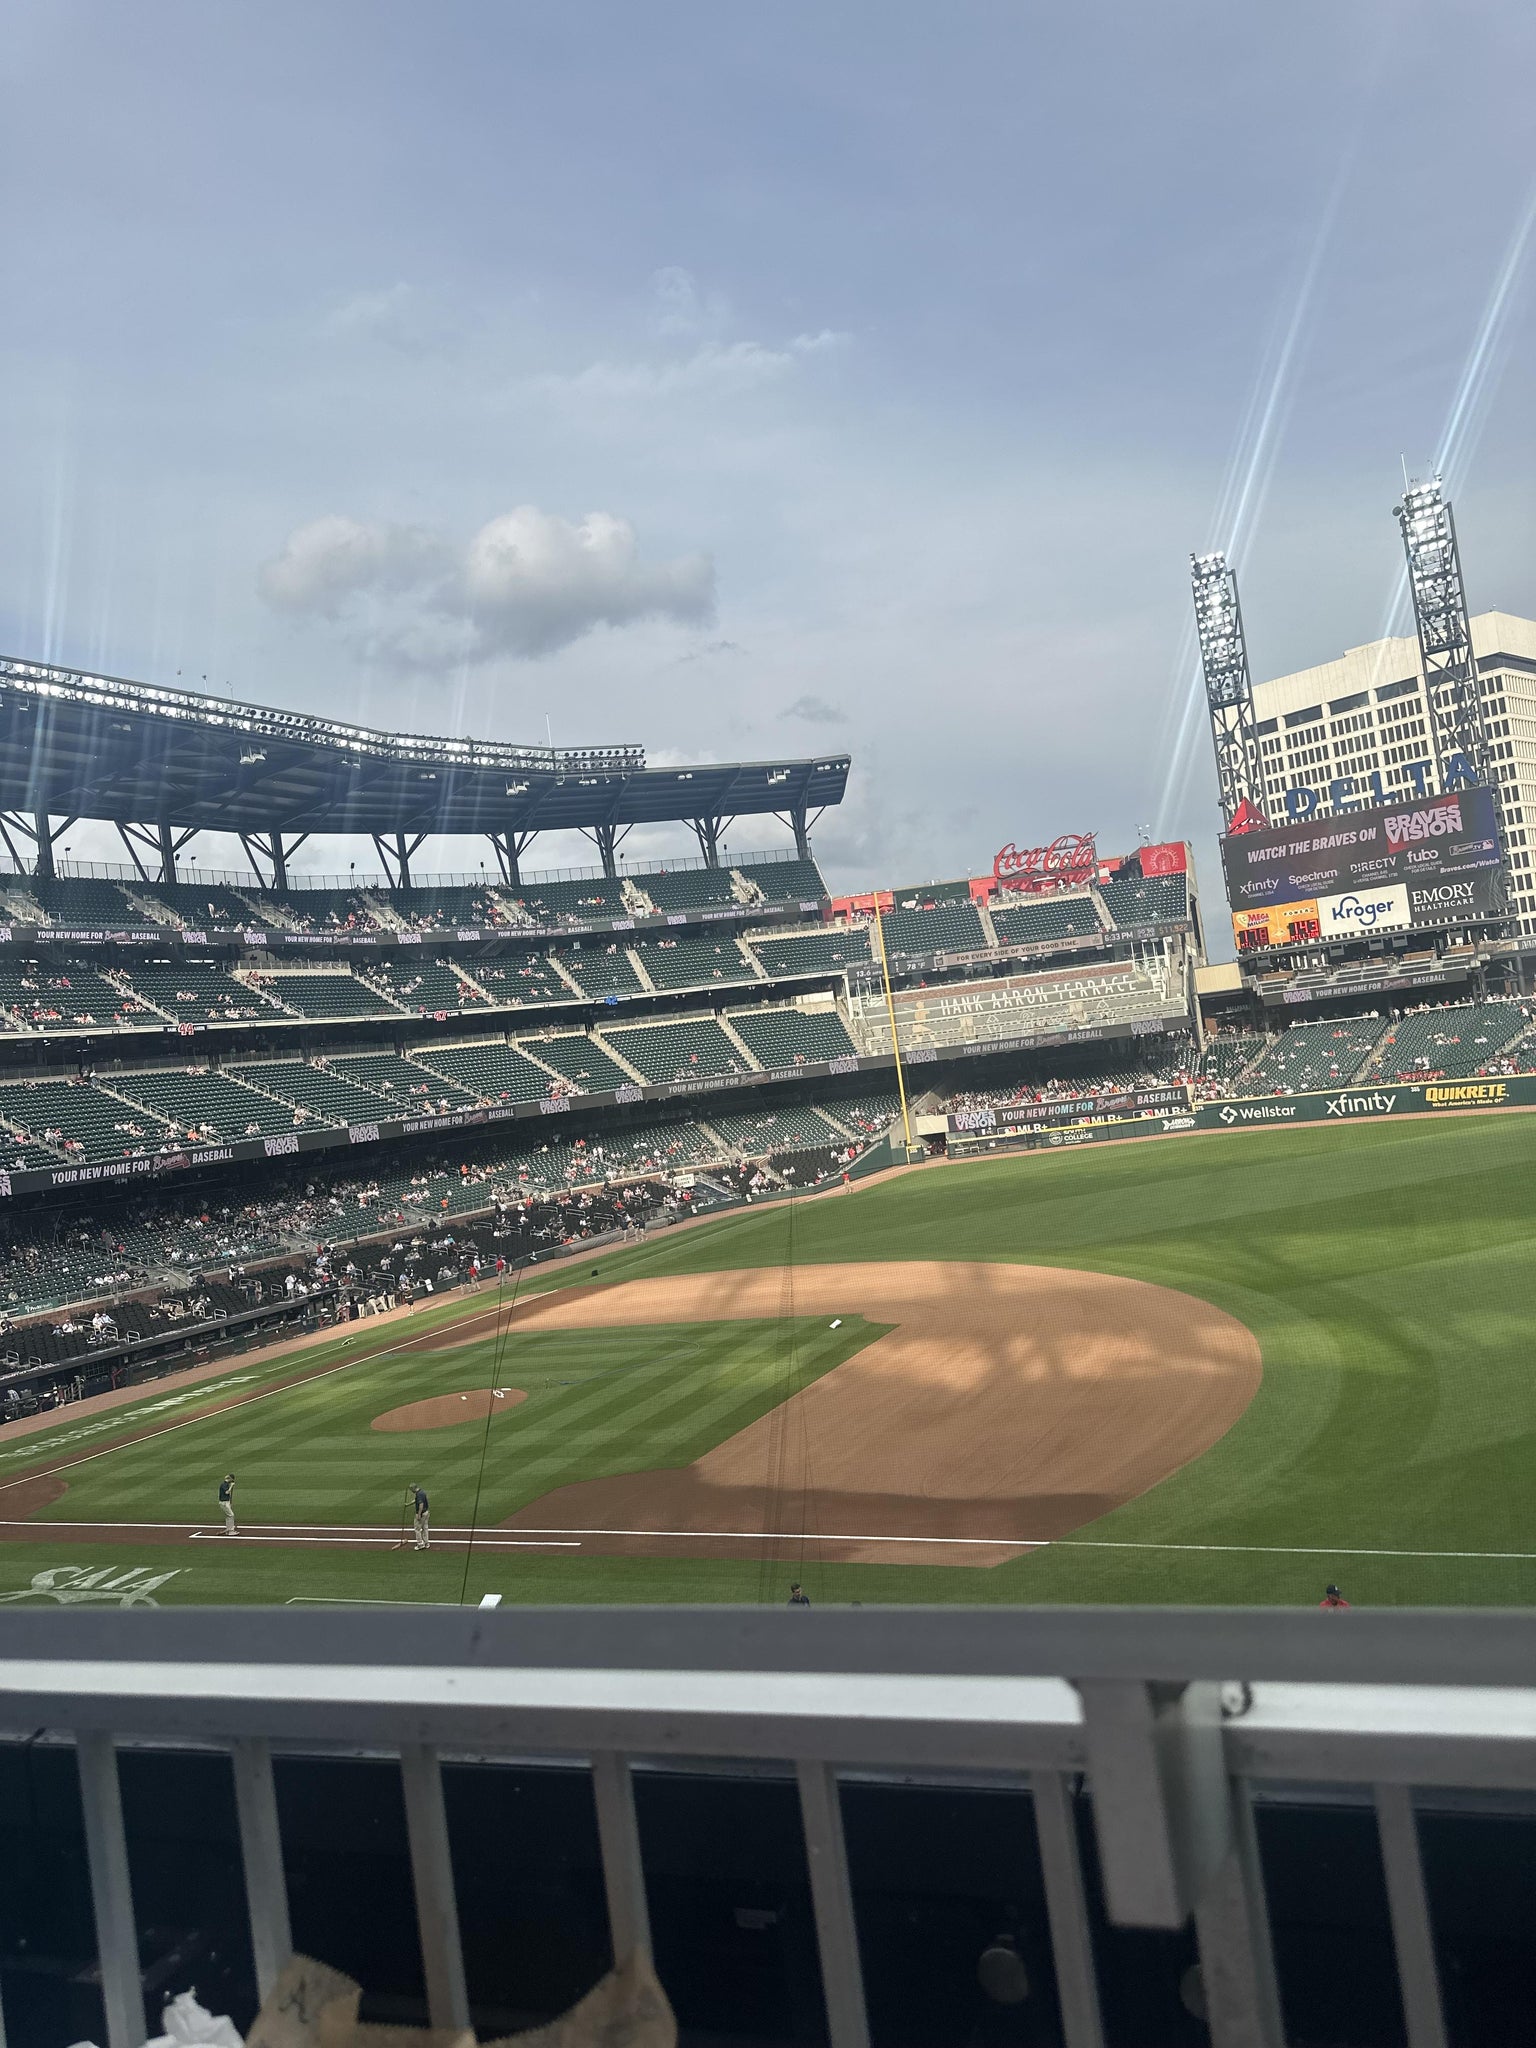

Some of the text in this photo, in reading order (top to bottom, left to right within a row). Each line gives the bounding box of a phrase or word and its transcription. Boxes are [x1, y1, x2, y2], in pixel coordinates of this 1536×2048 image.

[1285, 753, 1479, 820] DELTA
[1384, 805, 1461, 831] BRAVES
[1386, 817, 1463, 844] VISION
[1247, 827, 1377, 864] WATCH THE BRAVES ON
[993, 831, 1098, 879] Coca-Cola
[1407, 849, 1439, 863] fubo
[1350, 856, 1397, 874] DIRECTV
[1440, 858, 1500, 874] Braves.com/Watch
[1288, 869, 1338, 885] Spectrum
[1240, 877, 1279, 895] xfinity
[1411, 881, 1475, 905] EMORY
[1332, 896, 1394, 926] Kroger
[1414, 897, 1474, 912] HEALTHCARE
[1247, 913, 1269, 922] MEGA
[56, 931, 71, 939] NEW
[71, 931, 90, 939] HOME
[90, 931, 103, 939] FOR
[131, 932, 160, 940] BASEBALL
[1121, 931, 1134, 940] PM
[971, 952, 992, 960] EVERY
[993, 949, 1009, 957] SIDE
[1315, 989, 1332, 997] YOUR
[1333, 986, 1348, 996] NEW
[1349, 984, 1368, 993] HOME
[1368, 982, 1381, 991] FOR
[1412, 974, 1446, 985] BASEBALL
[940, 975, 1137, 1016] HANK AARON TERRACE
[178, 1022, 195, 1035] 44
[1131, 1025, 1164, 1036] VISION
[962, 1046, 981, 1054] YOUR
[982, 1043, 998, 1052] NEW
[999, 1040, 1020, 1049] HOME
[1020, 1038, 1034, 1047] FOR
[1067, 1029, 1103, 1041] BASEBALL
[906, 1055, 938, 1064] VISION
[830, 1064, 859, 1075] VISION
[668, 1083, 687, 1094] YOUR
[687, 1081, 703, 1092] NEW
[704, 1079, 725, 1089] HOME
[725, 1077, 739, 1086] FOR
[770, 1068, 804, 1080] BASEBALL
[616, 1094, 643, 1104] VISION
[1425, 1083, 1507, 1103] QUIKRETE
[541, 1104, 570, 1114] VISION
[1001, 1109, 1025, 1121] YOUR
[1026, 1107, 1048, 1118] NEW
[1048, 1105, 1074, 1116] HOME
[1076, 1102, 1093, 1112] FOR
[1137, 1090, 1182, 1105] BASEBALL
[1325, 1091, 1396, 1117] xfinity
[402, 1121, 419, 1132] YOUR
[419, 1119, 434, 1130] NEW
[434, 1117, 451, 1127] HOME
[451, 1115, 463, 1125] FOR
[488, 1108, 514, 1119] BASEBALL
[954, 1110, 995, 1121] BRAVES
[1239, 1105, 1296, 1120] Wellstar
[348, 1124, 379, 1135] BRAVES
[955, 1117, 997, 1131] VISION
[264, 1135, 298, 1149] BRAVES
[349, 1131, 380, 1143] VISION
[1063, 1132, 1094, 1141] COLLEGE
[265, 1142, 299, 1157] VISION
[51, 1169, 78, 1185] YOUR
[79, 1166, 101, 1181] NEW
[102, 1163, 131, 1178] HOME
[132, 1160, 150, 1175] FOR
[192, 1148, 234, 1164] BASEBALL
